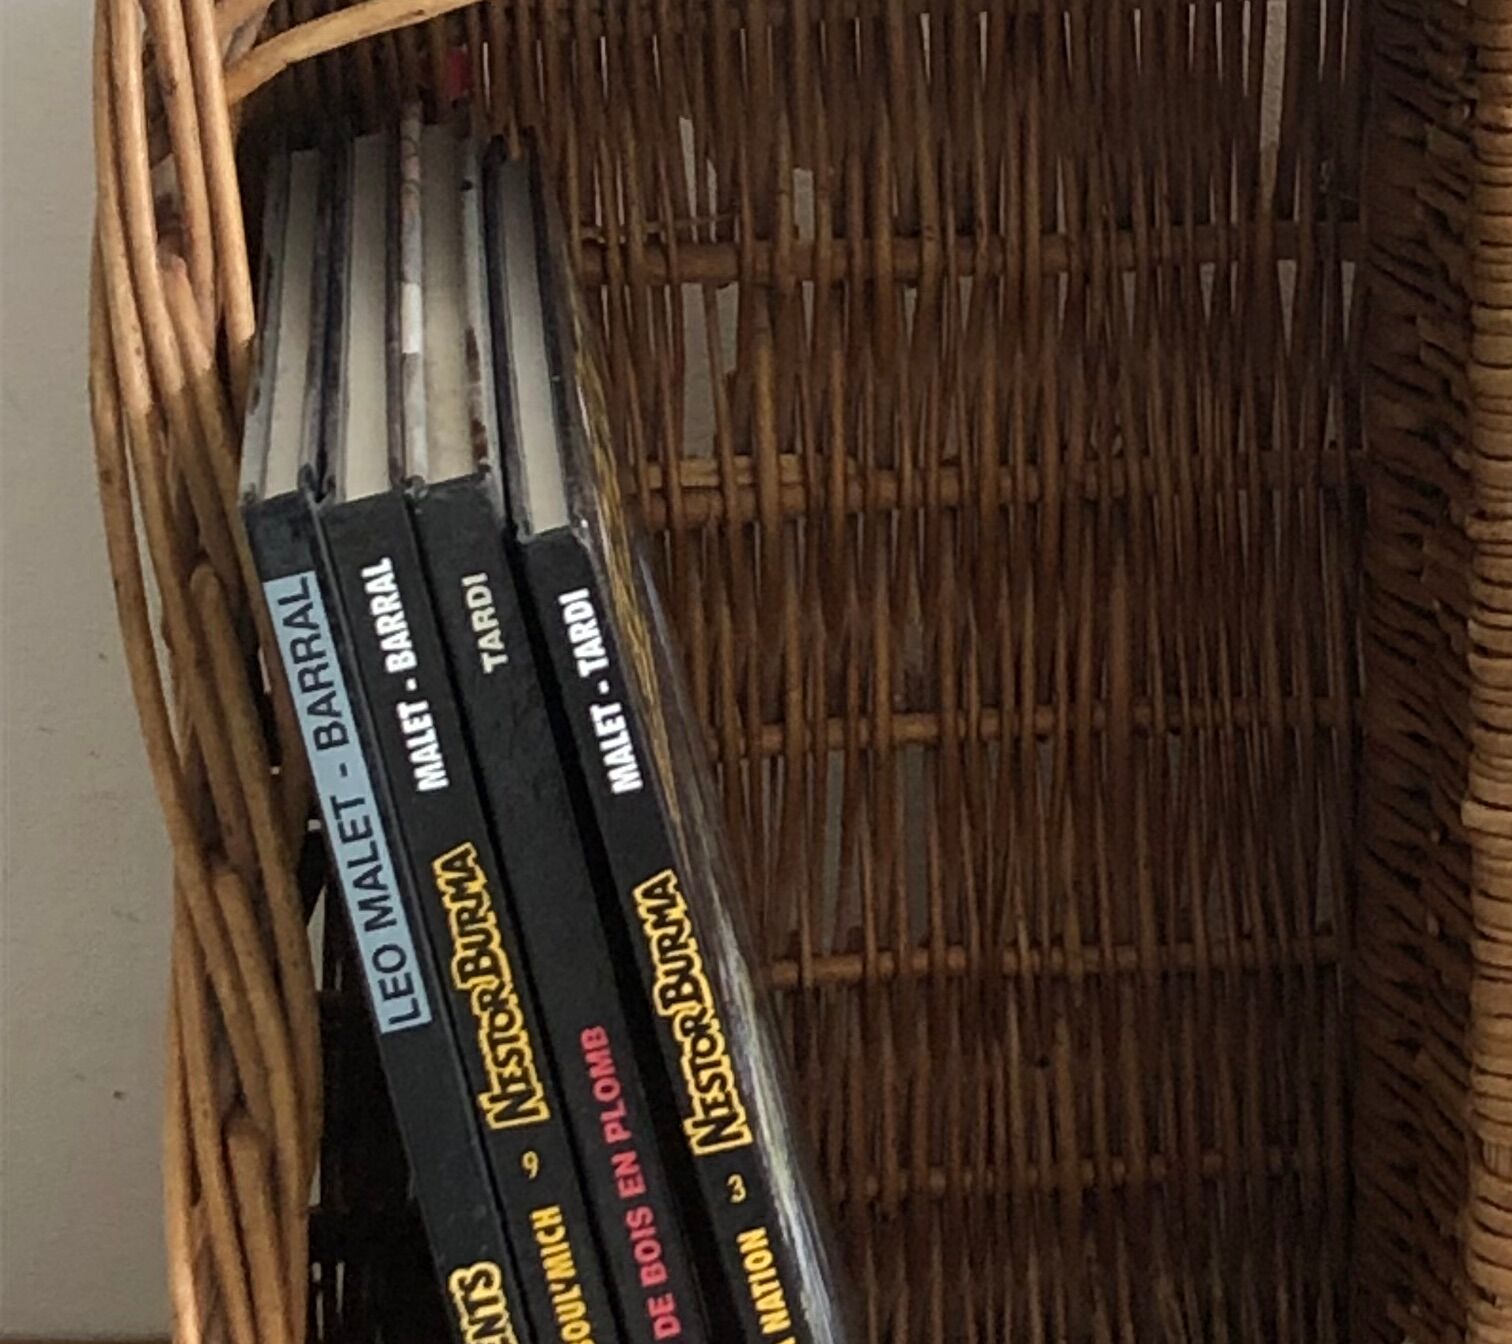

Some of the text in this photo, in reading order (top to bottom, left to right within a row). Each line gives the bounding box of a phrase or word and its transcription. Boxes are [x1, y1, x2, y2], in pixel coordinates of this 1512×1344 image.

[361, 558, 416, 673] BARRAL
[461, 572, 508, 673] TARDI
[558, 587, 609, 677] TARDI
[278, 576, 350, 752] BARRAL
[397, 698, 447, 791] MALET
[589, 703, 643, 793] MALET
[332, 795, 400, 933] MALET
[377, 944, 423, 1025] LEO
[580, 1025, 631, 1144] PLOMB
[521, 1150, 541, 1180] 9
[611, 1150, 646, 1198] EN
[727, 1173, 747, 1204] 3
[626, 1205, 669, 1287] BOIS
[737, 1226, 792, 1334] NATION
[647, 1293, 681, 1340] DE
